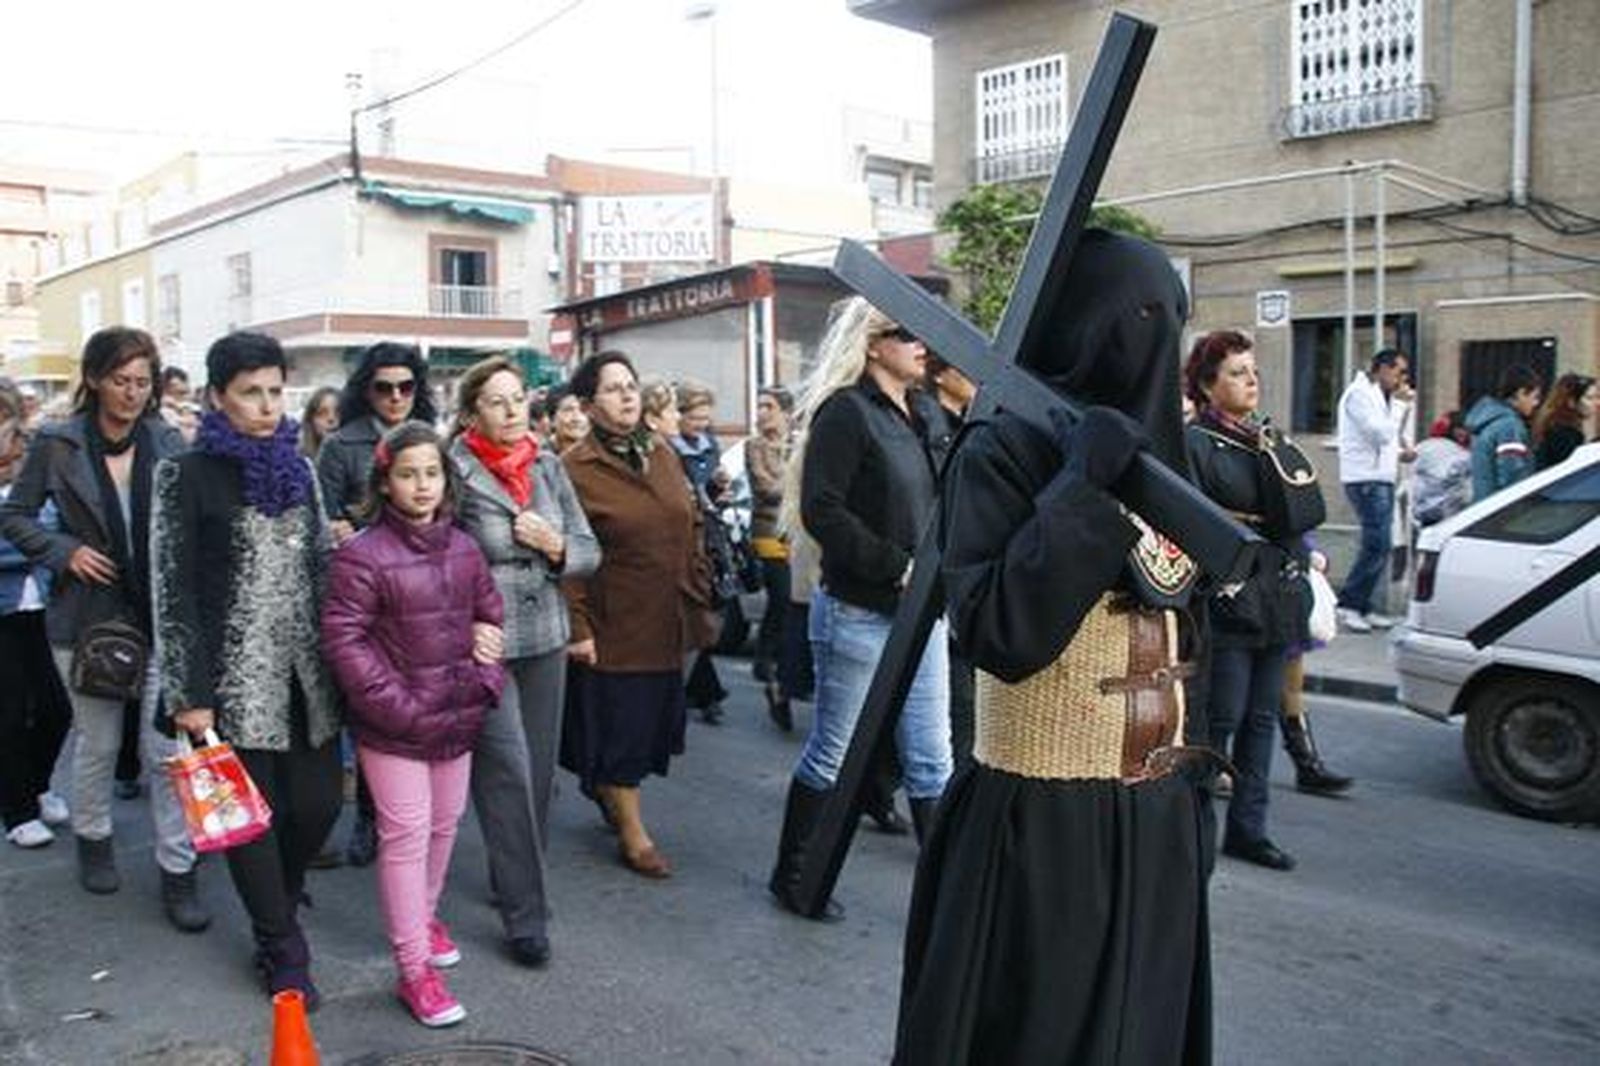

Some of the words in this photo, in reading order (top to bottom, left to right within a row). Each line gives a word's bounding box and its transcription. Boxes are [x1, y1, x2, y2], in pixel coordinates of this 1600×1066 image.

[598, 201, 627, 226] LA
[588, 231, 710, 257] TRATTORIA
[627, 280, 733, 318] TRATTORIA
